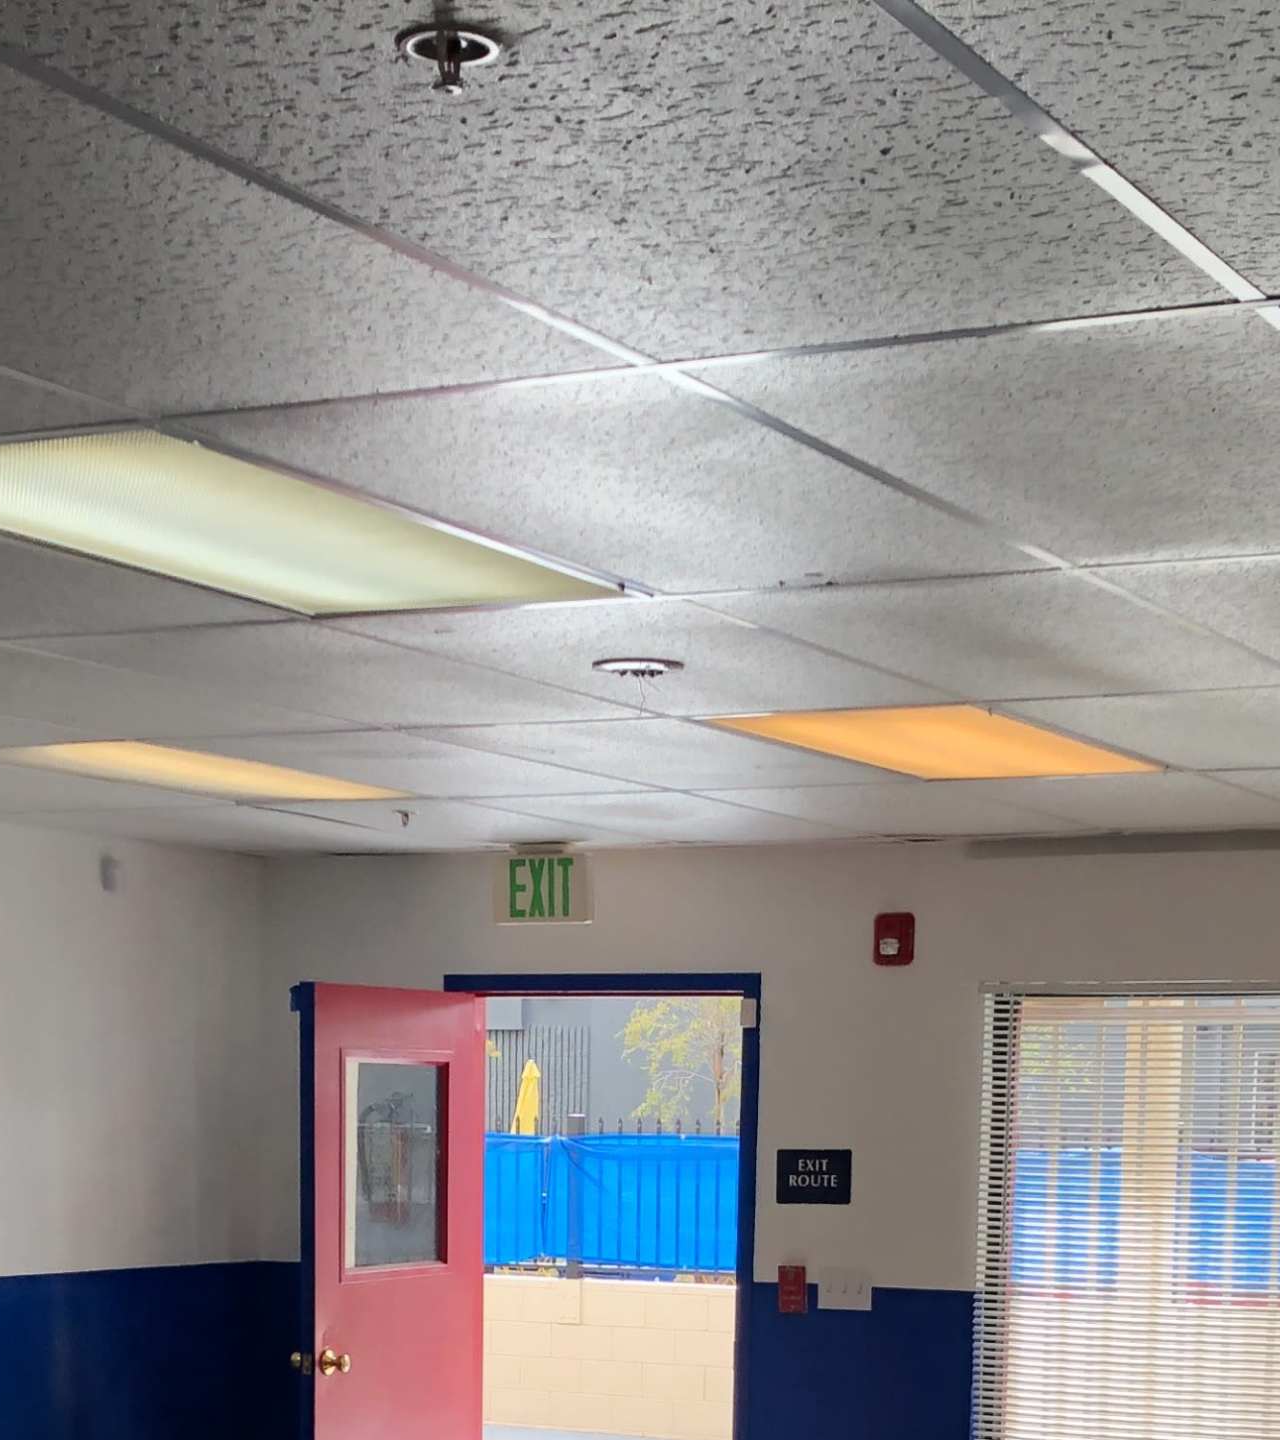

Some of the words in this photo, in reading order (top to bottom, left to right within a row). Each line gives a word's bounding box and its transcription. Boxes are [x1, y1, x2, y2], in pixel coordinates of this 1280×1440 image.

[509, 857, 574, 918] EXIT
[798, 1159, 829, 1172] EXIT
[788, 1174, 838, 1188] ROUTE
